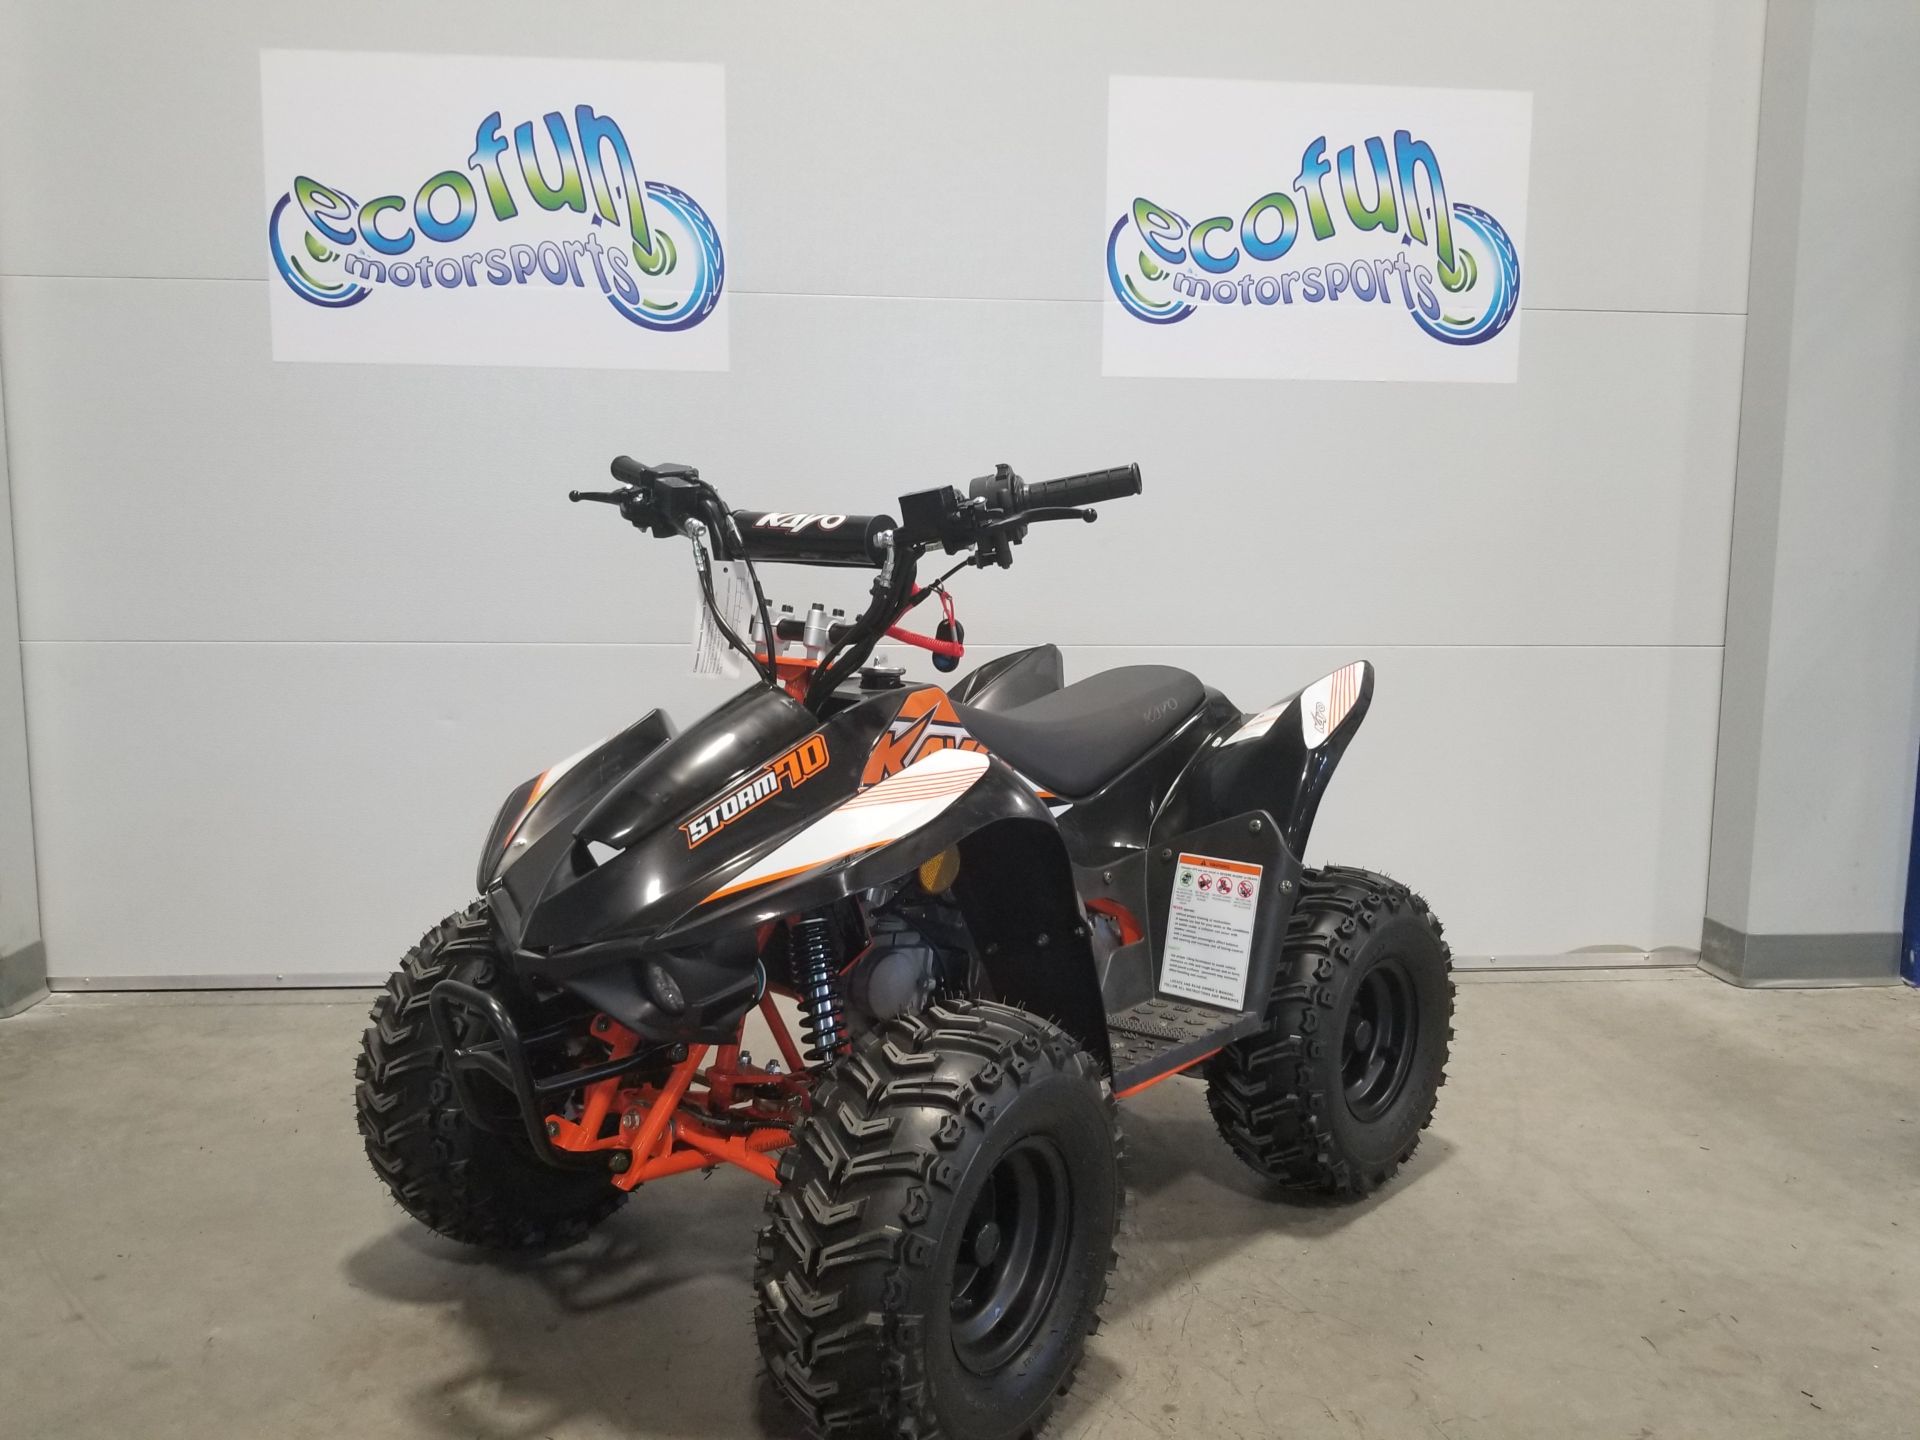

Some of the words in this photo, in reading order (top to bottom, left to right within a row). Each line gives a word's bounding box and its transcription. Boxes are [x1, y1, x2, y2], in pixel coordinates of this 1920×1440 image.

[344, 232, 640, 305] motorsports
[1172, 251, 1441, 320] motorsports
[687, 770, 779, 843] STORM
